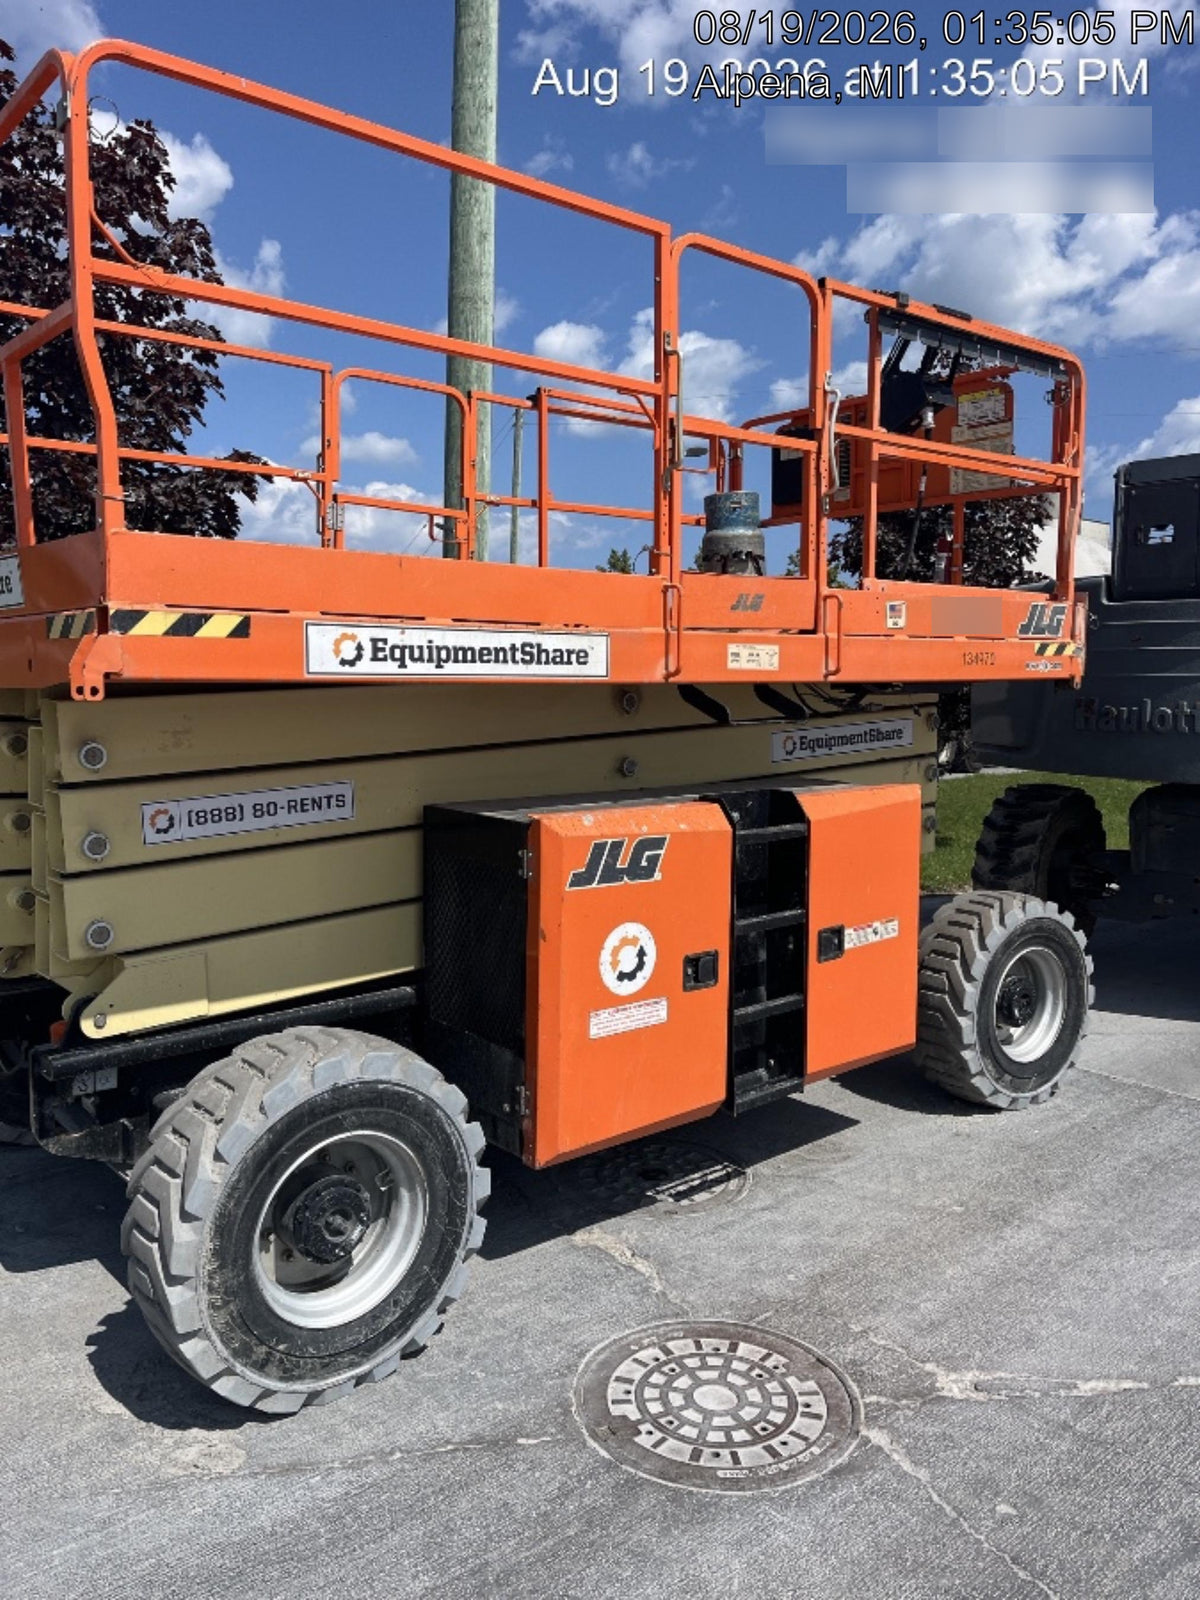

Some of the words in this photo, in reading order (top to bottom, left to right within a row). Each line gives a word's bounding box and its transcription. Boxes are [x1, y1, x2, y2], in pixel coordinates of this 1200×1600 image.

[730, 593, 766, 612] JLG
[1016, 602, 1070, 638] JLG
[369, 637, 590, 669] EquipmentShare
[799, 727, 904, 753] EquipmentShare
[187, 803, 245, 828] (888)
[253, 793, 346, 819] 80-RENTS
[565, 834, 670, 891] JLG
